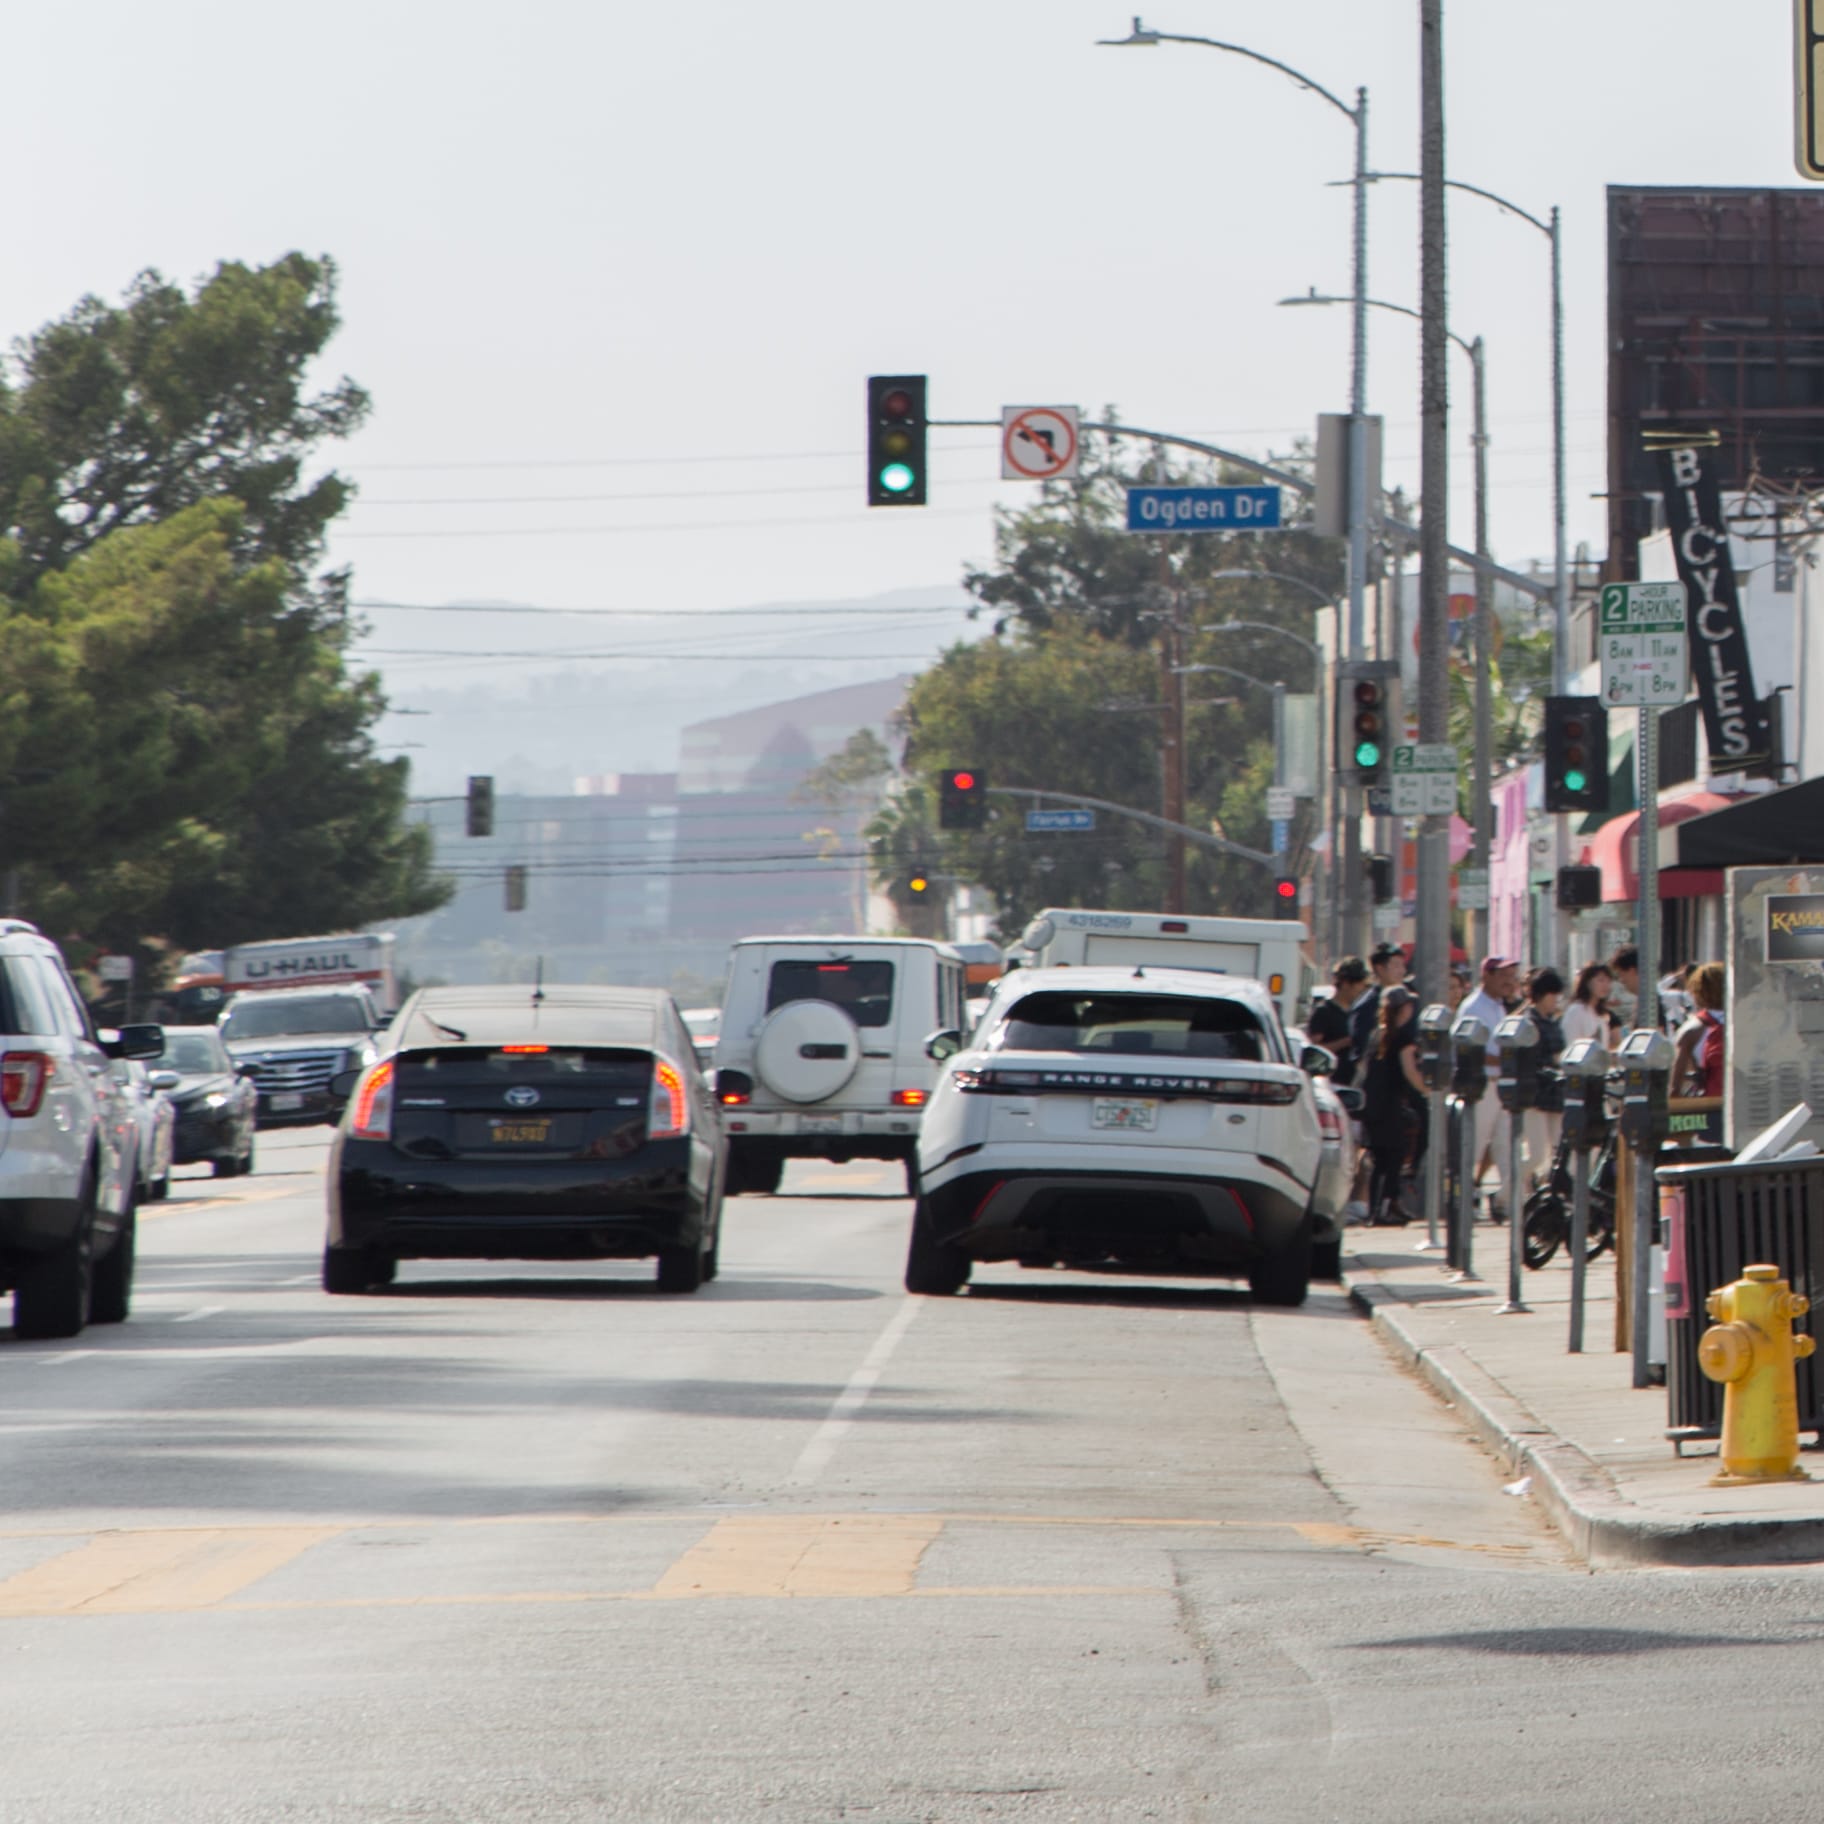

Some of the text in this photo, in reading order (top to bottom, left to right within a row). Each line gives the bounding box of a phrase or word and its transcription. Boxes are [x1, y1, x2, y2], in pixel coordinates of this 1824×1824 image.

[1140, 495, 1267, 526] Ogden Dr
[1607, 589, 1623, 620] 2
[1631, 599, 1682, 620] PARKING
[1671, 448, 1751, 756] BICYCLES
[246, 953, 358, 978] U-HAUL
[1045, 1074, 1210, 1089] RANGE ROVER
[1669, 1114, 1709, 1133] PECIAL
